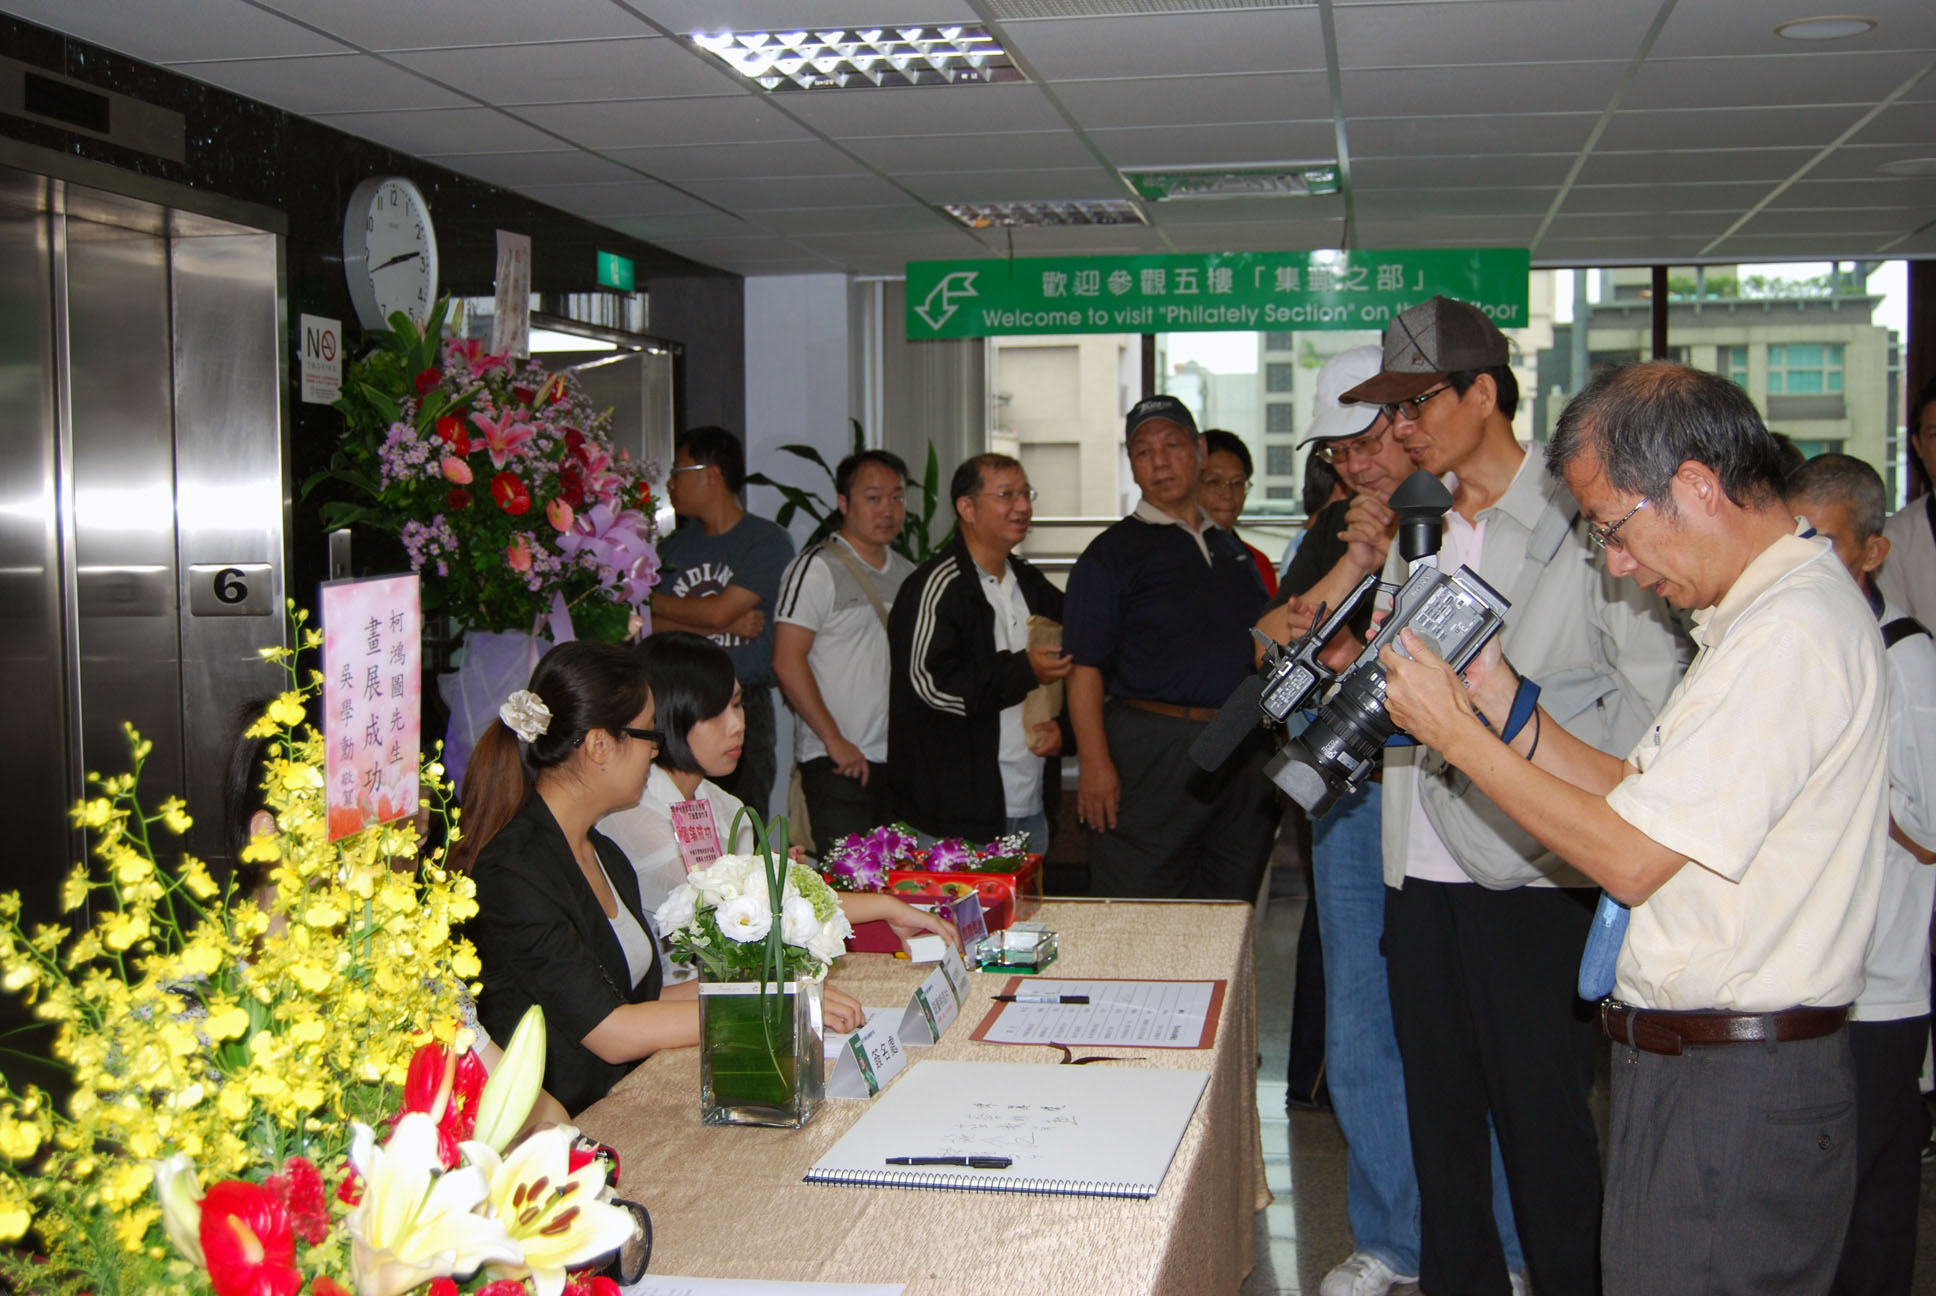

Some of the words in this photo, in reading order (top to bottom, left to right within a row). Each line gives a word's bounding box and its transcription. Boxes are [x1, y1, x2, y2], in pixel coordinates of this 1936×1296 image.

[390, 189, 398, 207] 12
[415, 223, 422, 240] 2
[419, 256, 426, 273] 3
[982, 308, 1082, 327] Welcome
[1088, 306, 1109, 326] to
[1114, 304, 1153, 325] visit
[1159, 303, 1258, 326] "Philately
[1264, 303, 1352, 323] Section"
[1361, 305, 1388, 321] on
[214, 567, 248, 604] 6
[363, 616, 383, 796] 畫展成功
